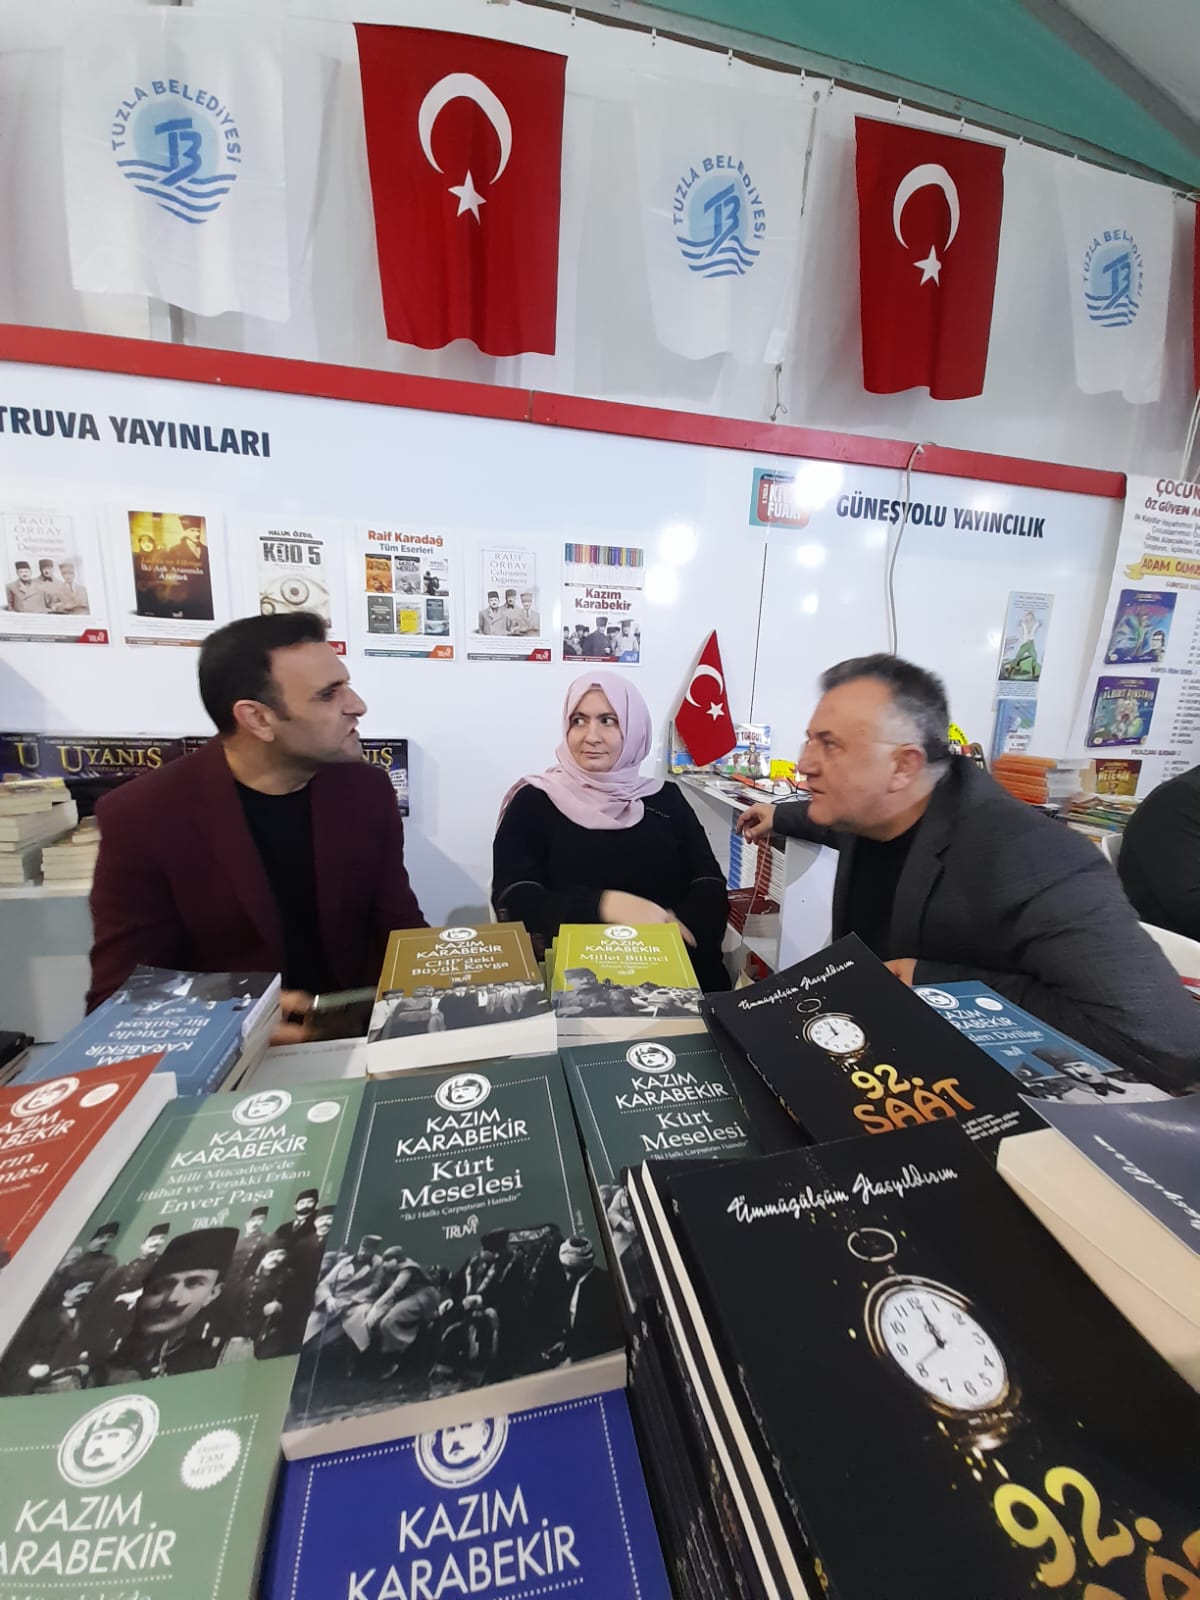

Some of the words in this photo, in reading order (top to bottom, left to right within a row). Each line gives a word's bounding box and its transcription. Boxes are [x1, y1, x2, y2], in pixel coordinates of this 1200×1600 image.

[111, 87, 149, 152] TUZLA
[673, 168, 700, 225] TUZLA
[0, 405, 100, 441] TRUVA
[109, 415, 271, 457] YAYINLARI
[836, 490, 947, 528] GÜNEŞYOLU
[953, 507, 1046, 538] YAYINCILIK
[1145, 497, 1158, 510] ÖZ
[368, 530, 392, 541] Raif
[394, 532, 444, 547] Karadağ
[380, 543, 399, 552] Tüm
[401, 545, 433, 554] Eserleri
[307, 545, 321, 566] 5
[489, 560, 528, 570] ORBAY
[1141, 558, 1171, 571] ADAM
[575, 598, 632, 611] Karabekir
[585, 588, 622, 600] Kazım
[416, 944, 503, 959] KARABEKİR
[435, 940, 485, 951] KAZIM
[585, 945, 662, 953] KARABEKİR
[600, 939, 645, 947] KAZIM
[411, 963, 460, 976] Büyük
[463, 961, 509, 970] Kavga
[580, 953, 621, 962] Millet
[624, 954, 669, 963] Bilinci
[938, 1009, 988, 1020] AZIM
[949, 1016, 1018, 1030] RABEKİR
[172, 1026, 201, 1038] Bir
[85, 1040, 195, 1056] KARABEKİR
[631, 1071, 698, 1091] KAZIM
[615, 1080, 729, 1109] KARABEKİR
[853, 1077, 977, 1135] SAAT
[0, 1109, 61, 1134] AZIM
[426, 1107, 501, 1134] KAZIM
[655, 1108, 714, 1130] Kürt
[0, 1118, 76, 1149] BEKİR
[208, 1123, 287, 1147] KAZIM
[396, 1117, 528, 1157] KARABEKİR
[639, 1121, 747, 1153] Meselesi
[170, 1133, 308, 1168] KARABEKİR
[430, 1154, 494, 1183] Kürt
[398, 1168, 524, 1211] Meselesi
[159, 1195, 225, 1216] Enver
[228, 1188, 275, 1205] Paşa
[15, 1490, 144, 1534] KAZIM
[399, 1483, 529, 1553] KAZIM
[994, 1465, 1163, 1588] 92.
[347, 1517, 581, 1600] KARABEKİR
